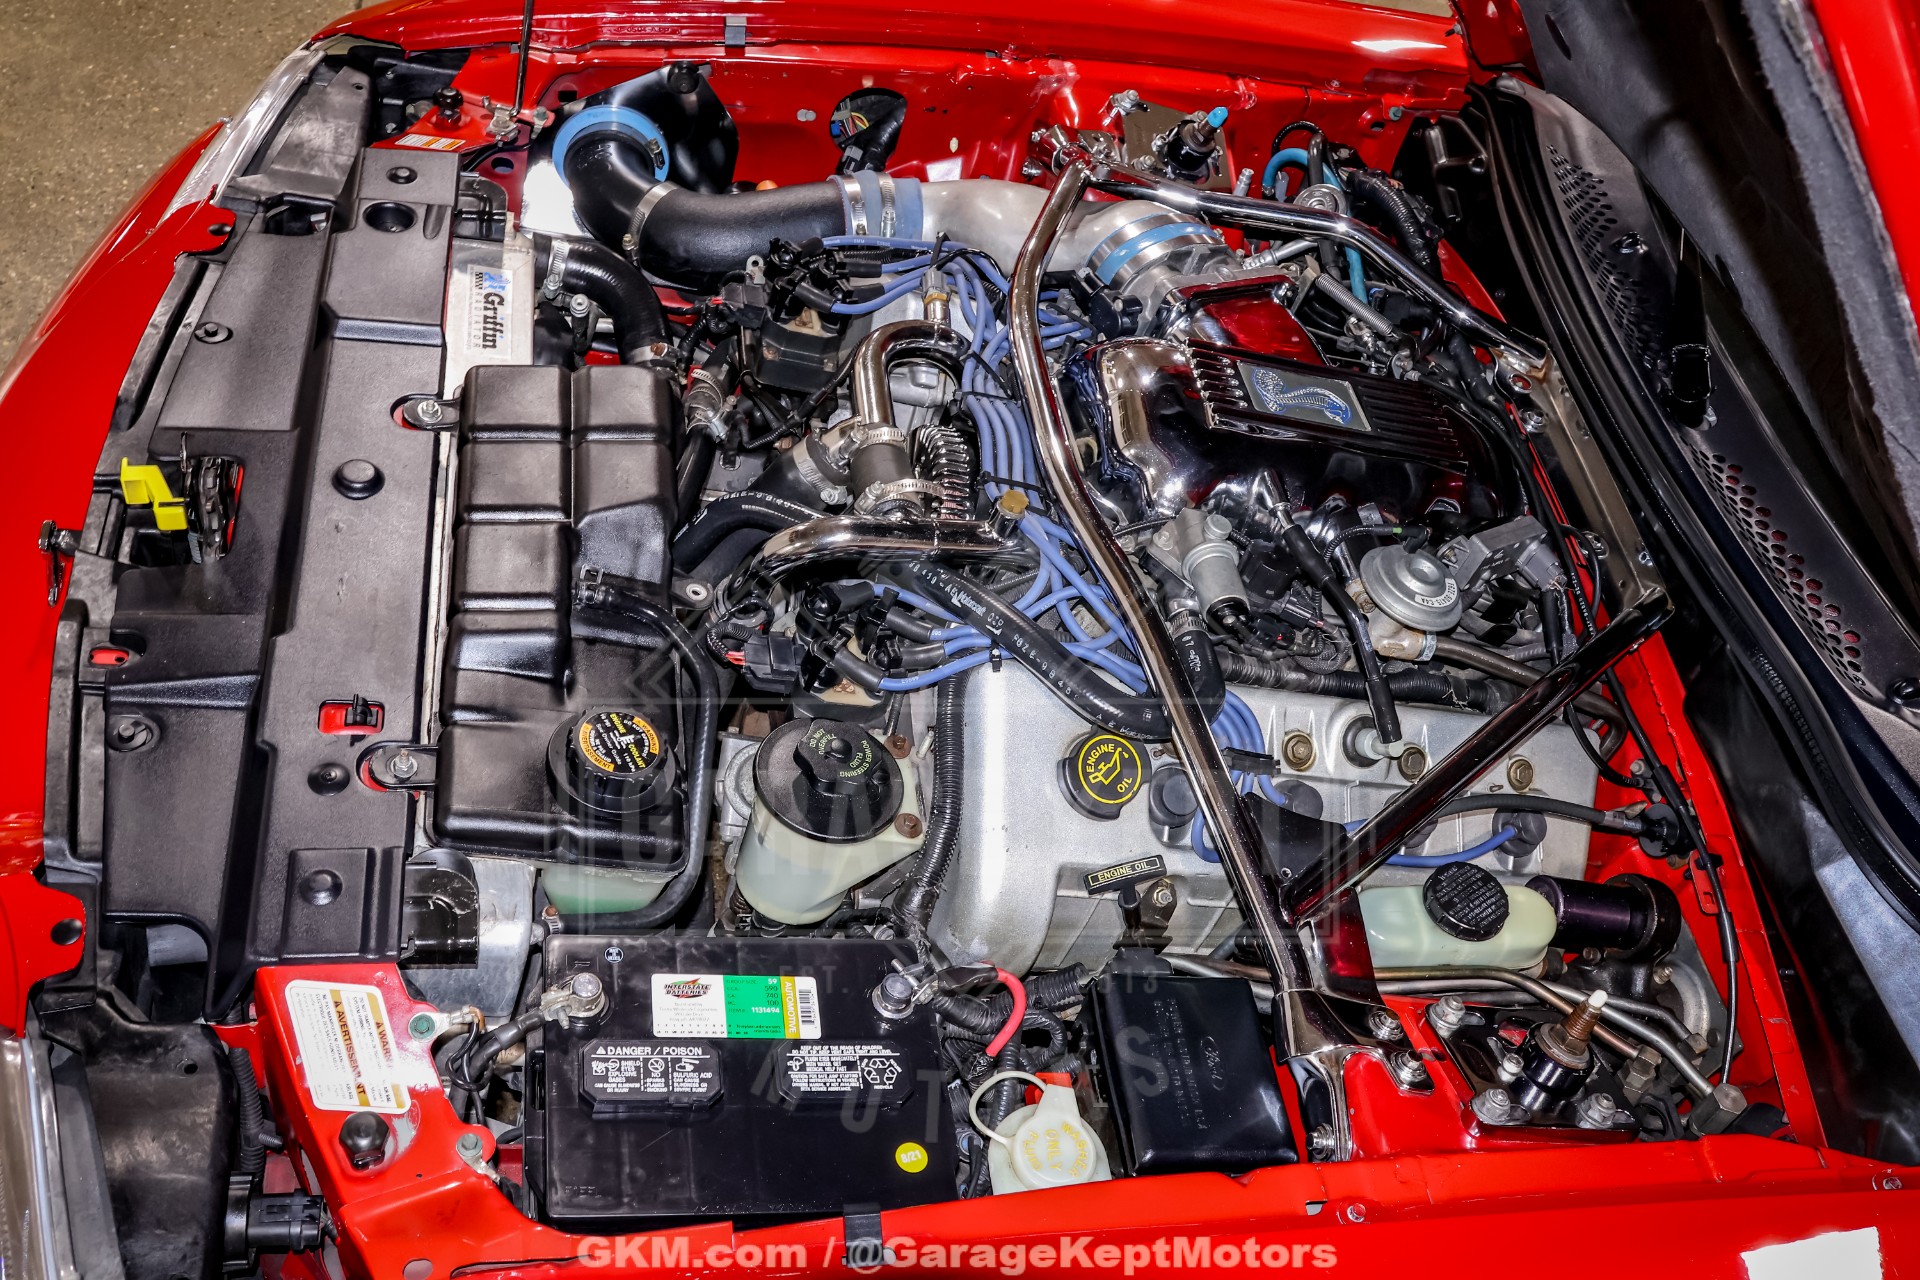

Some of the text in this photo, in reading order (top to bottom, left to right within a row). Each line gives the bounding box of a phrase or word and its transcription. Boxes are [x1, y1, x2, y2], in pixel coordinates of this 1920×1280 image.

[473, 292, 482, 348] RADIATOR
[482, 292, 505, 350] Griffin
[610, 713, 626, 734] ENGINE
[632, 724, 643, 732] NOT
[642, 724, 657, 752] WARNING
[809, 728, 825, 748] DO NOT
[819, 734, 837, 755] OVERFILL
[628, 744, 646, 768] COOLANT
[840, 740, 872, 777] POWER STEERING
[850, 752, 863, 768] FLUID
[1086, 743, 1115, 773] ENGINE
[1117, 777, 1132, 793] OIL
[1098, 862, 1150, 881] ENGINE OIL
[785, 981, 797, 1034] AUTOMOTIVE
[607, 1047, 651, 1055] DANGER
[663, 1047, 702, 1055] POISON
[900, 1149, 922, 1163] 8/21
[1024, 1130, 1042, 1171] FLUID
[1045, 1128, 1062, 1171] ONLY
[1062, 1122, 1088, 1178] WASHER
